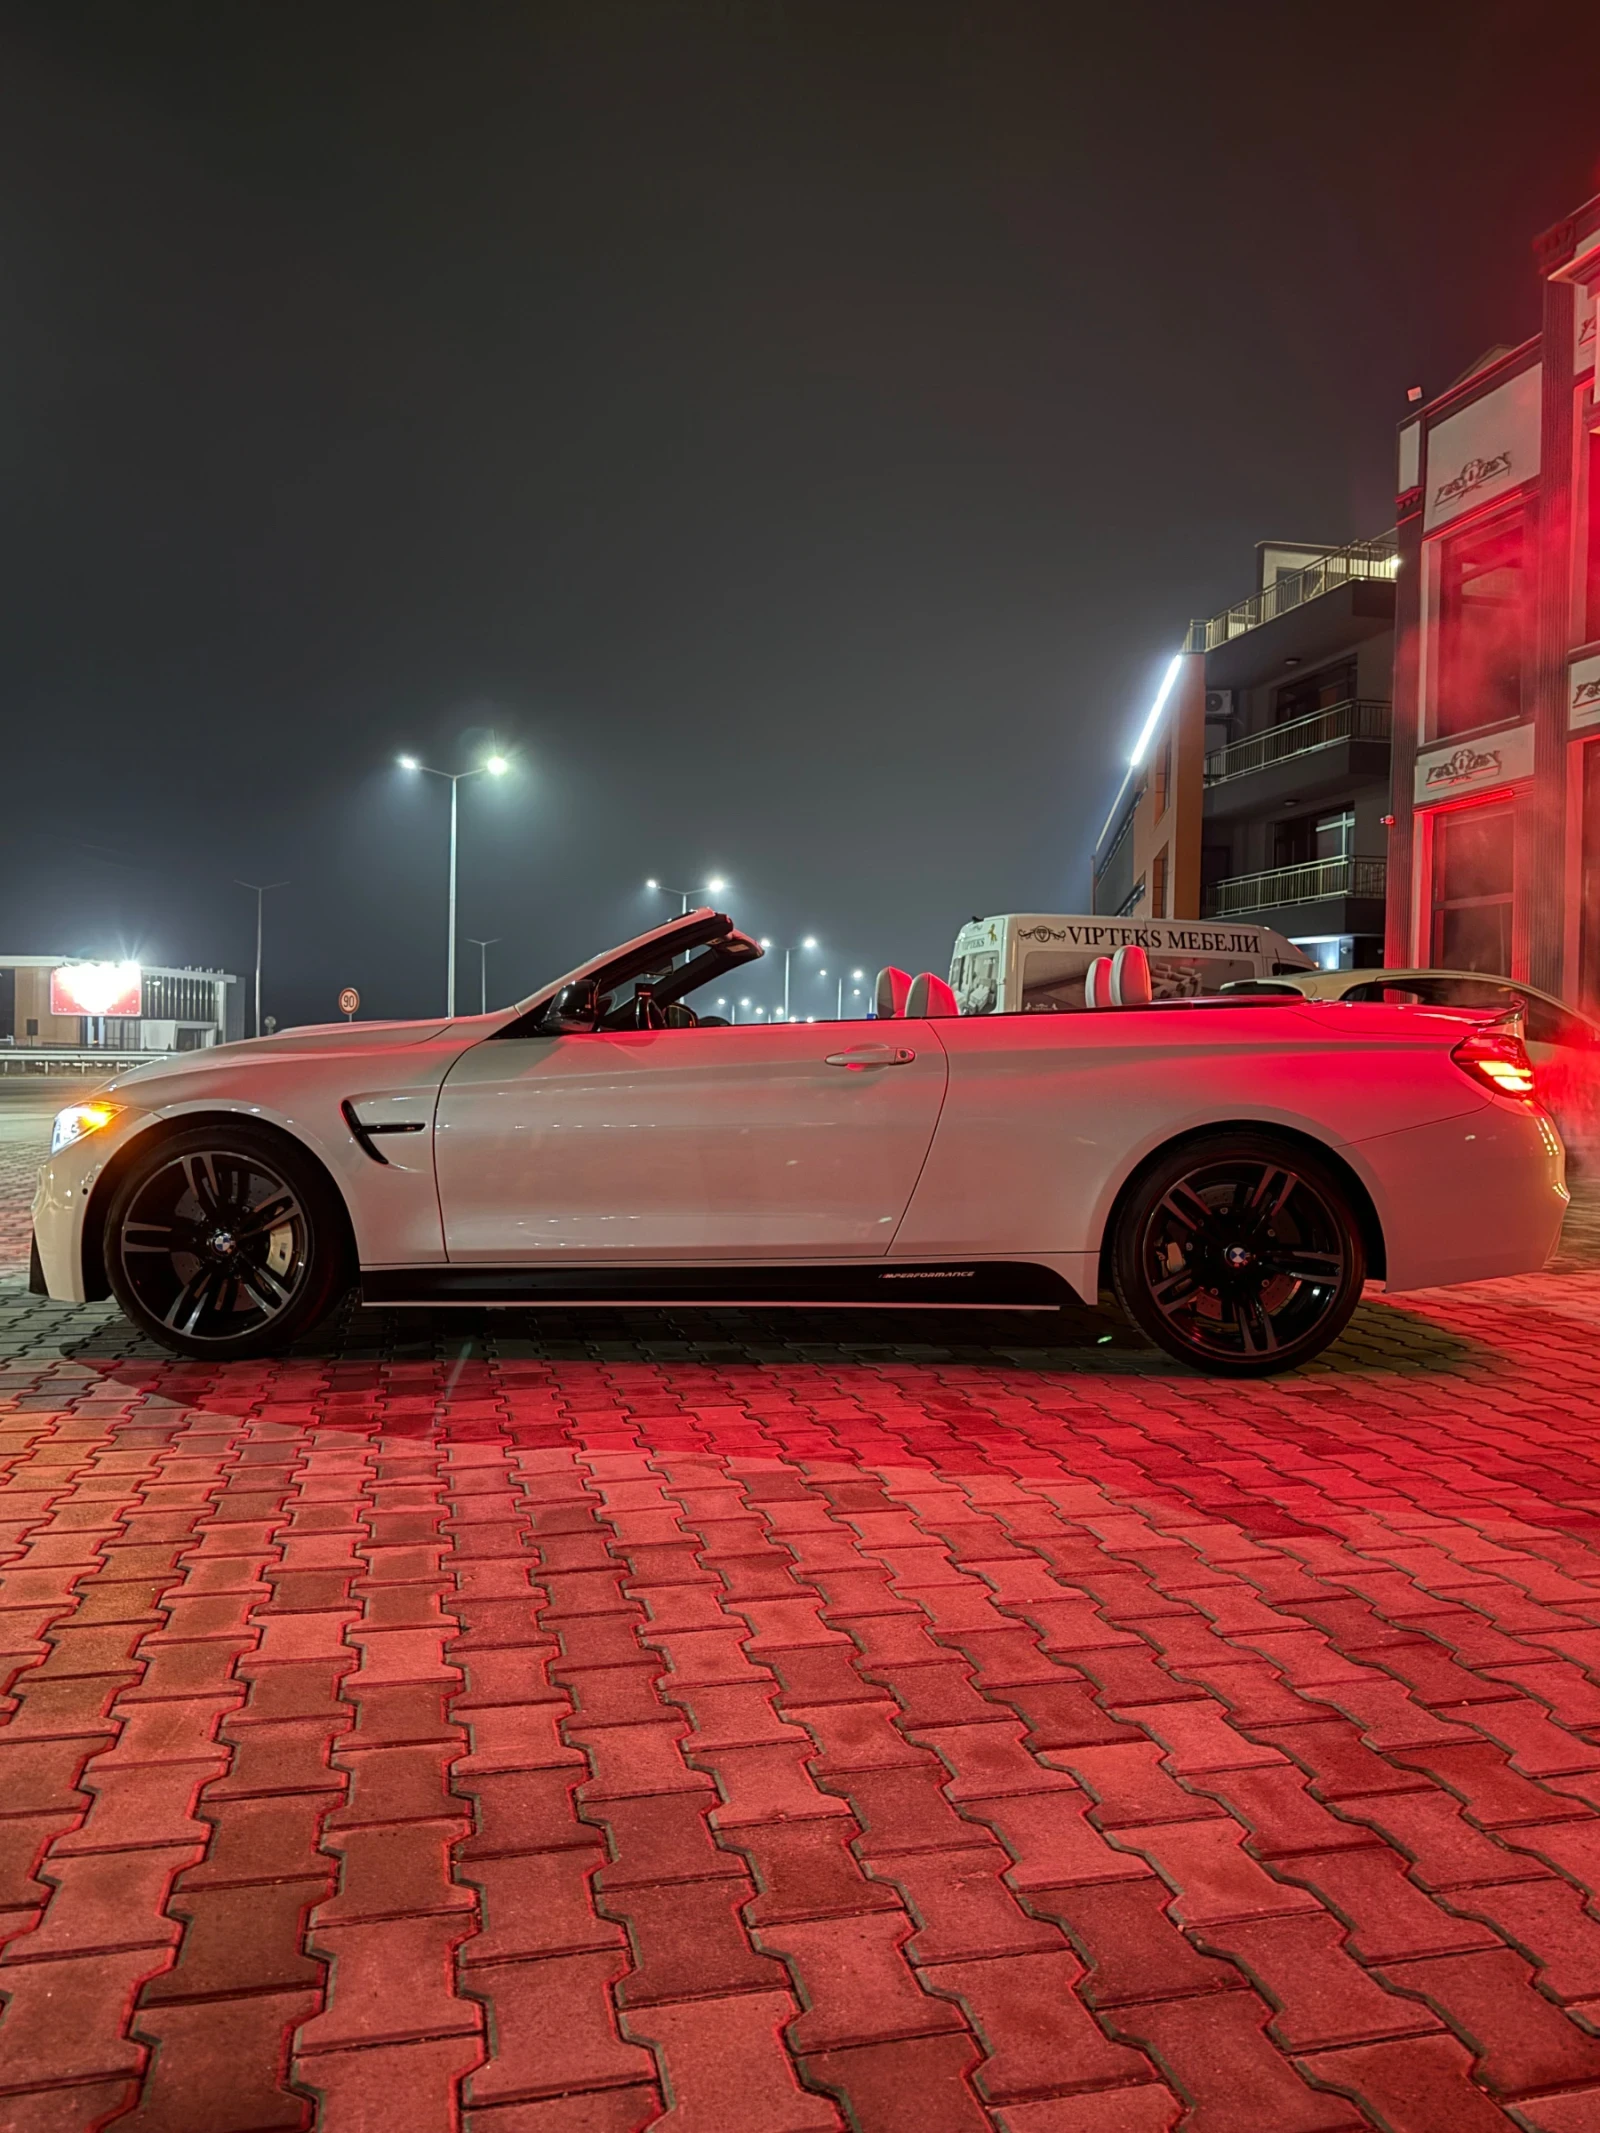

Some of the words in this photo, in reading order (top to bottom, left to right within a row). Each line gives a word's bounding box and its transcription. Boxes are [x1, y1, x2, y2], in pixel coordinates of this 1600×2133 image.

[1067, 926, 1162, 948] VIPTEKS
[1168, 930, 1260, 953] МЕБЕЛИ
[343, 995, 355, 1008] 90
